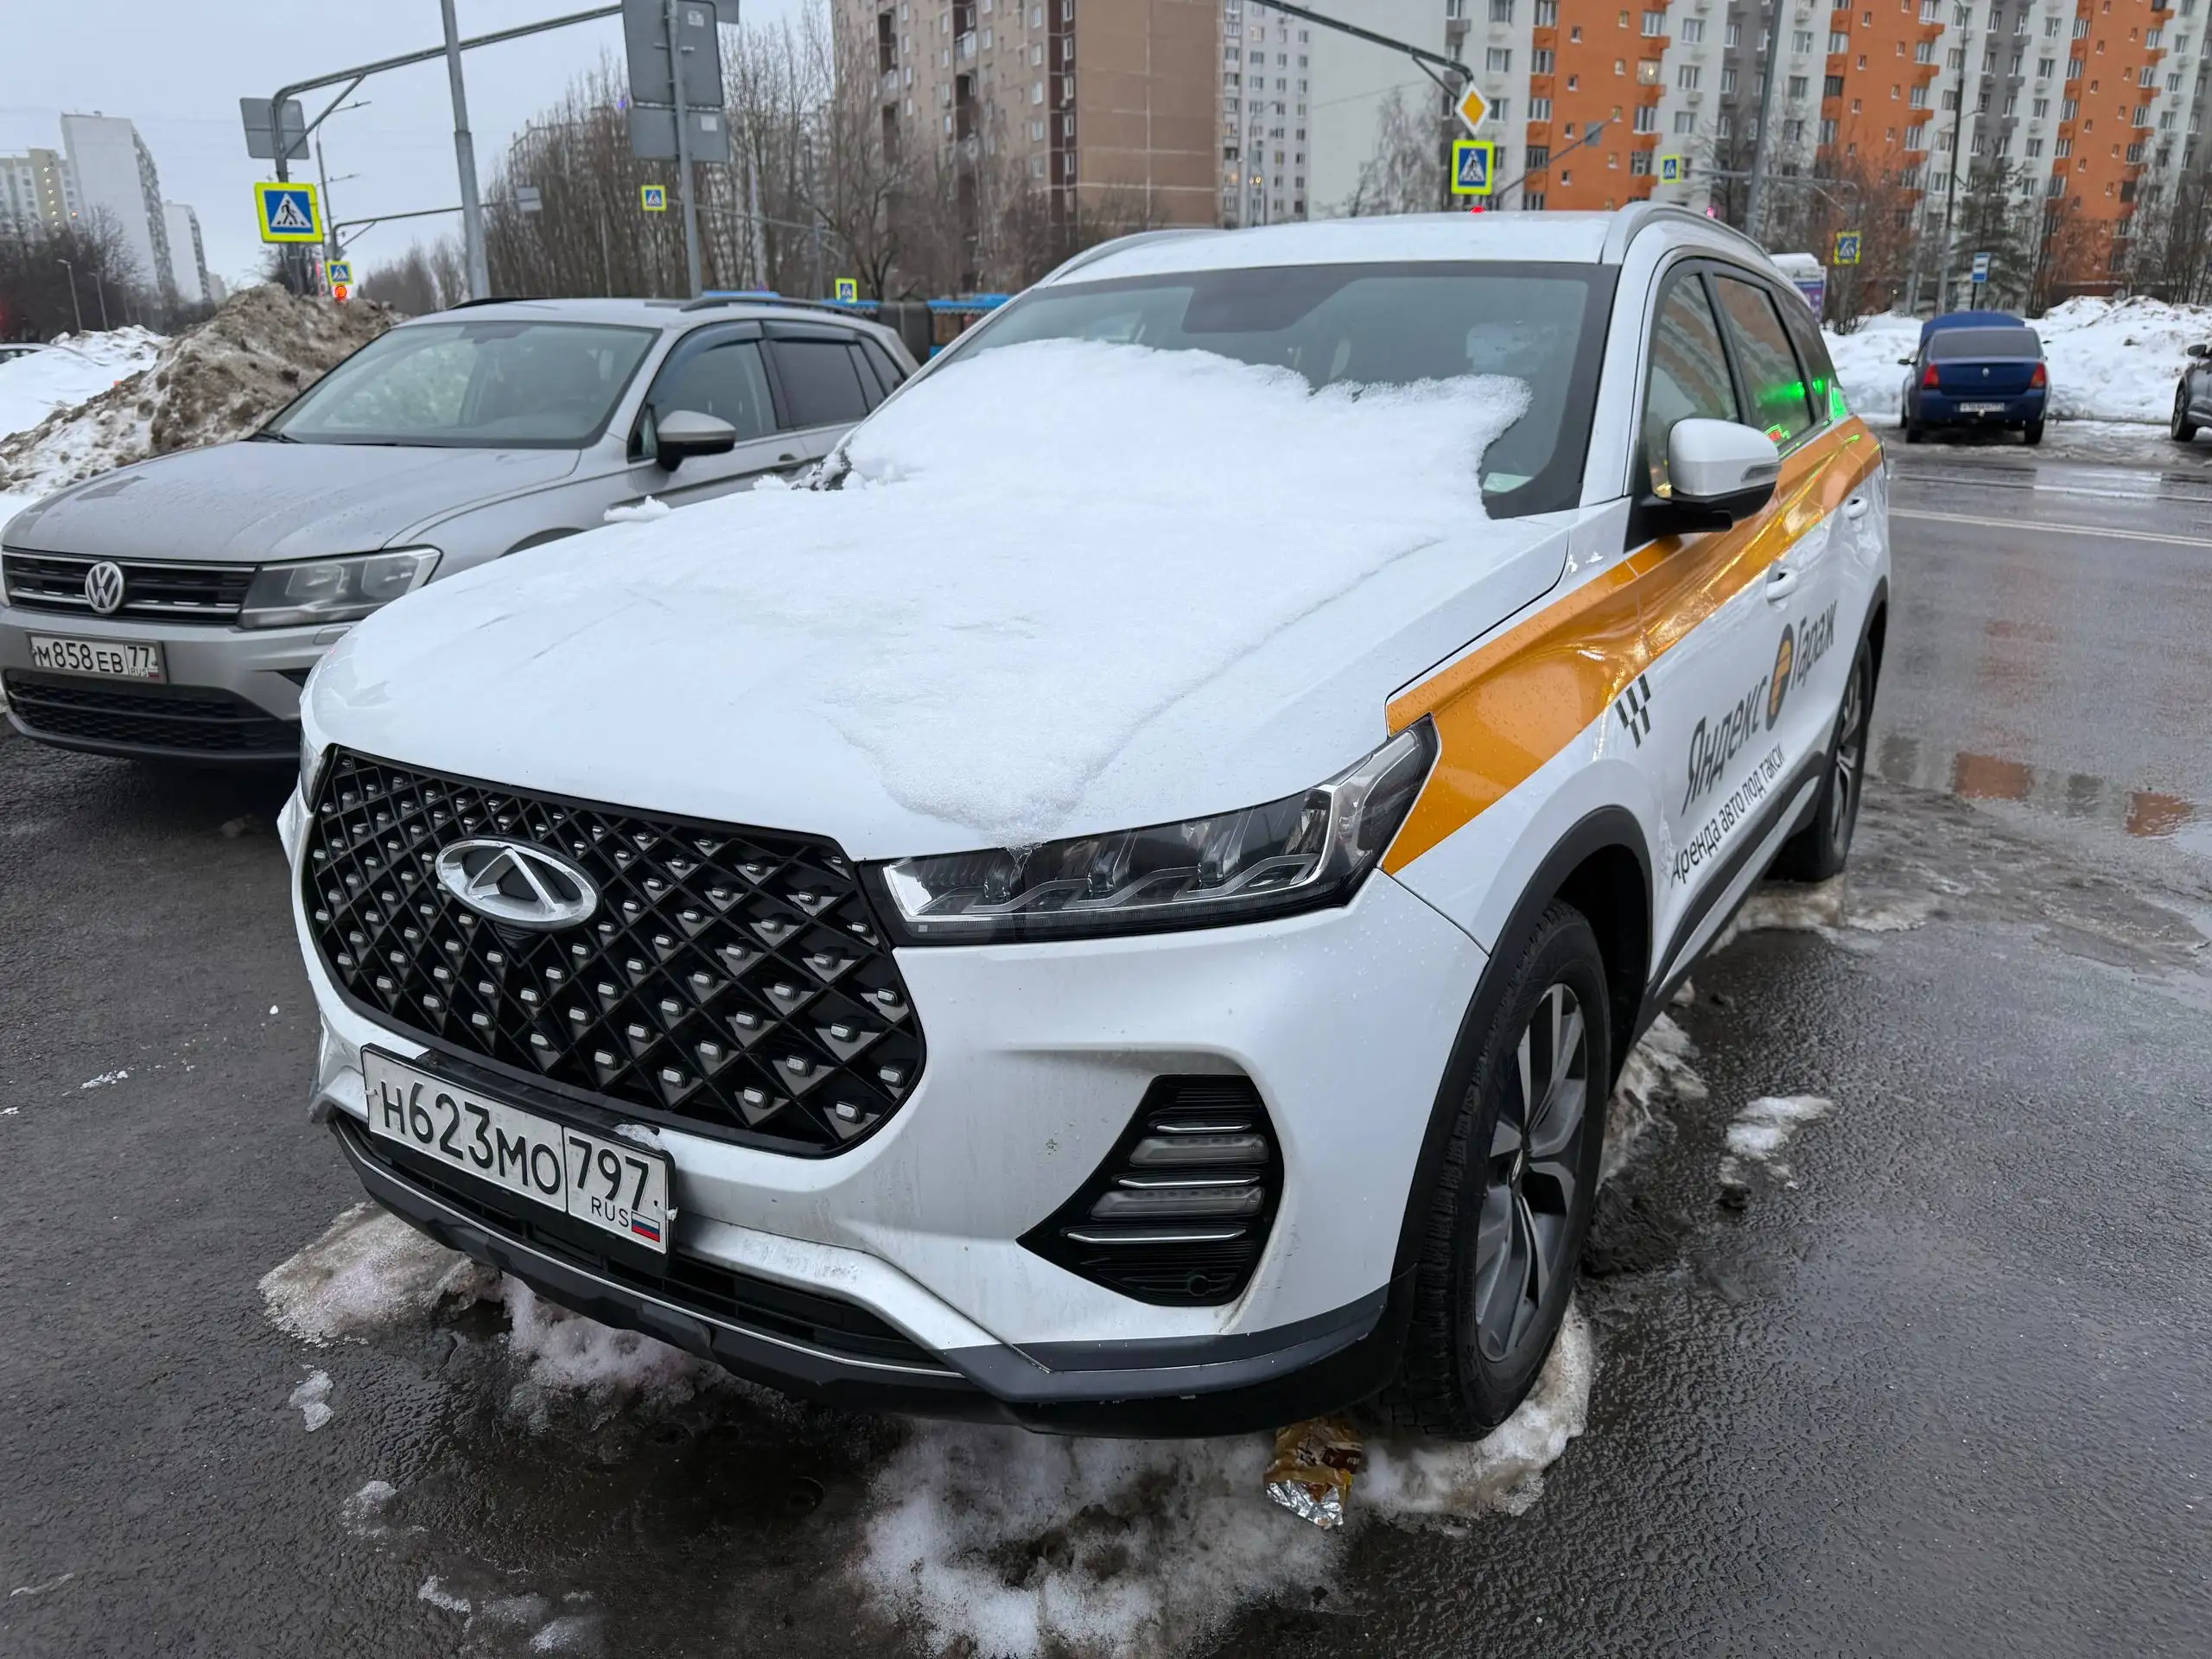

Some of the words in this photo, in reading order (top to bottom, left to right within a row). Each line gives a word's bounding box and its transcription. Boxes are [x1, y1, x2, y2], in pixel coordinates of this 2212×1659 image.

[36, 641, 124, 673] М858ЕВ
[127, 646, 150, 668] 77
[1681, 676, 1767, 817] Яндекс
[1791, 600, 1838, 690] Гараж
[1670, 817, 1722, 889] Аренда
[1720, 790, 1746, 833] авто
[1743, 768, 1768, 807] под
[1760, 741, 1786, 784] такси
[380, 1080, 562, 1196] Н623МО
[569, 1136, 650, 1211] 797
[591, 1196, 630, 1229] RUS
